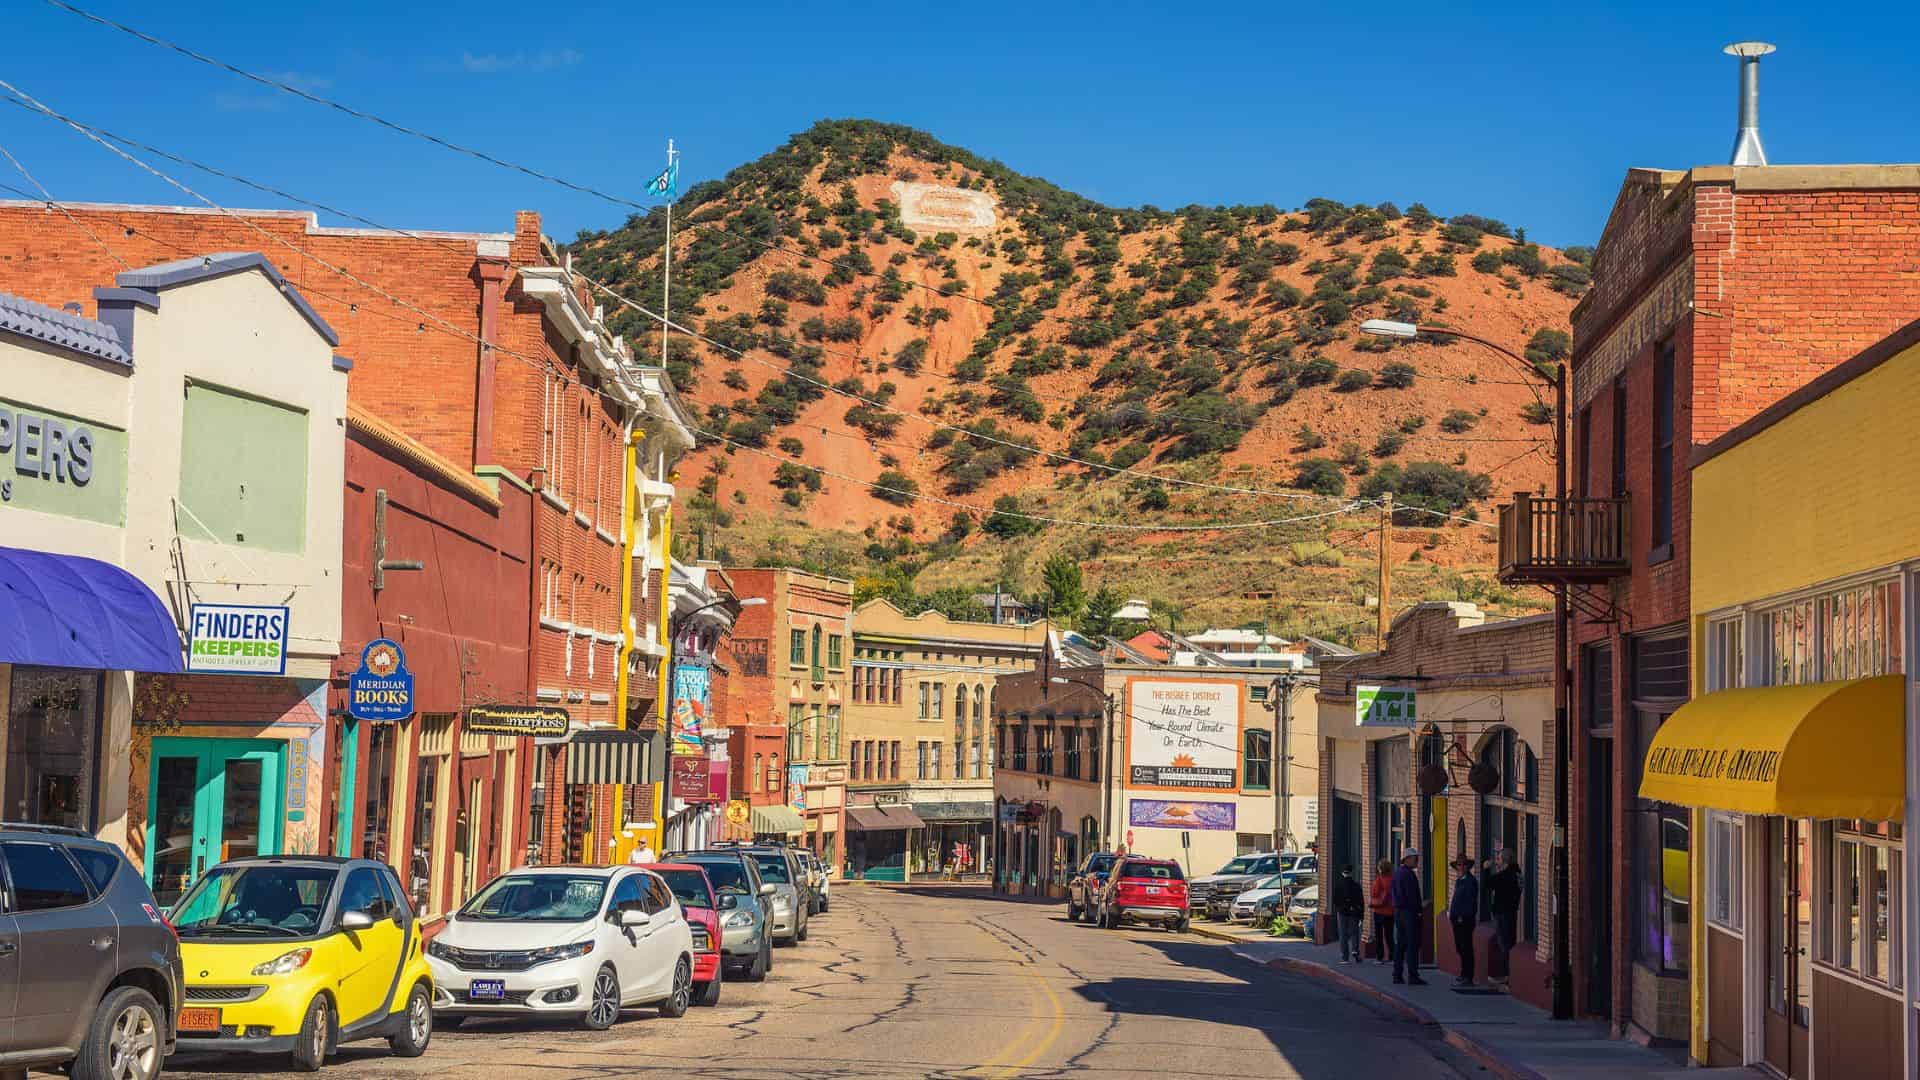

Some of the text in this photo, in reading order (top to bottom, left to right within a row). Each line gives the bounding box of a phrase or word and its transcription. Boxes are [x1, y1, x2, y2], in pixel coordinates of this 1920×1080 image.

[194, 612, 282, 640] FINDERS
[192, 640, 280, 658] KEEPERS
[358, 679, 405, 689] MERIDIAN
[355, 690, 408, 705] BOOKS
[1161, 703, 1211, 716] Has The Best
[1168, 720, 1193, 732] Round
[1197, 720, 1225, 733] Climate
[1163, 735, 1203, 748] On Earth
